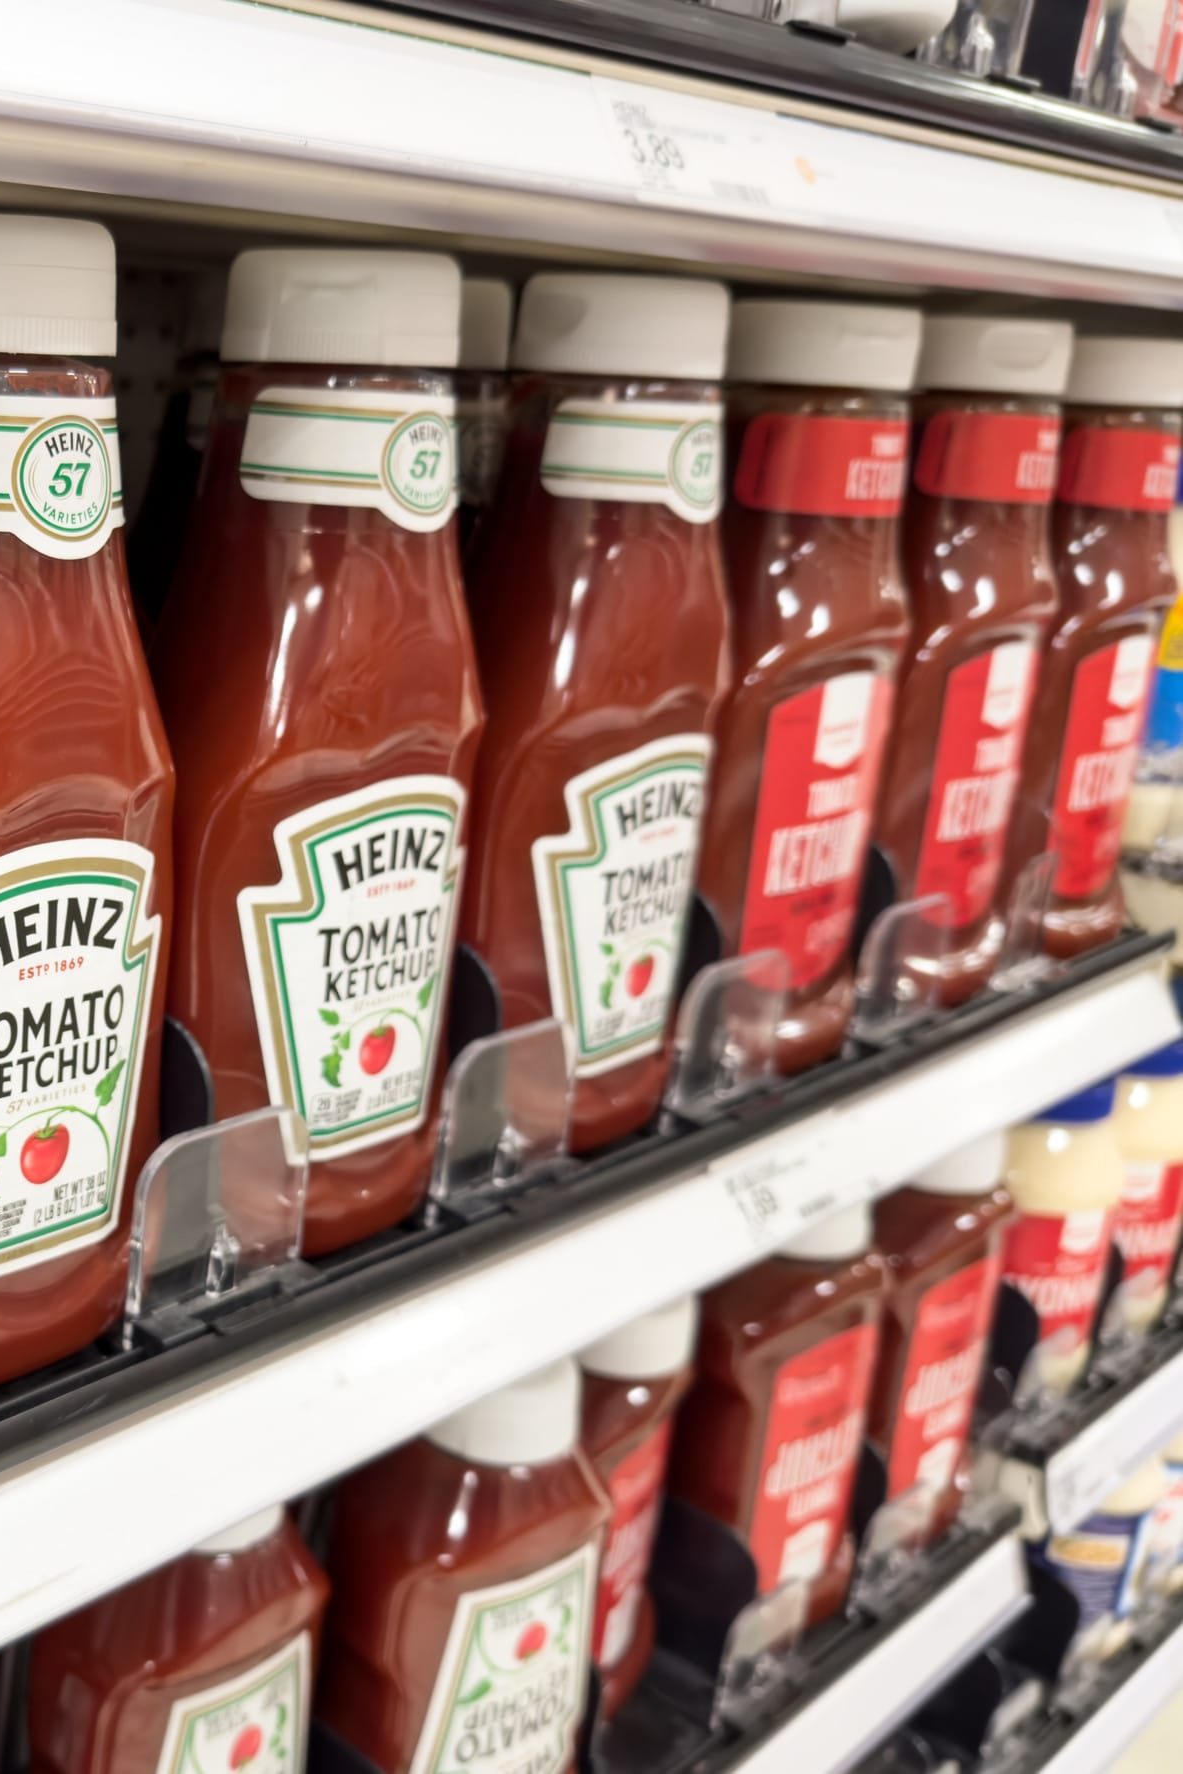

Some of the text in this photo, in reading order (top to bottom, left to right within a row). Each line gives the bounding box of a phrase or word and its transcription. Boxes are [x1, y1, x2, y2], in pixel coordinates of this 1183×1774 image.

[45, 432, 94, 457] HEINZ
[409, 450, 442, 479] 57
[48, 463, 92, 498] 57
[43, 502, 98, 525] VARIETIES
[616, 781, 701, 837] HEINZ
[333, 827, 446, 891] HEINZ
[319, 905, 443, 968] TOMATO
[54, 956, 84, 975] 1869
[6, 1099, 24, 1115] 57
